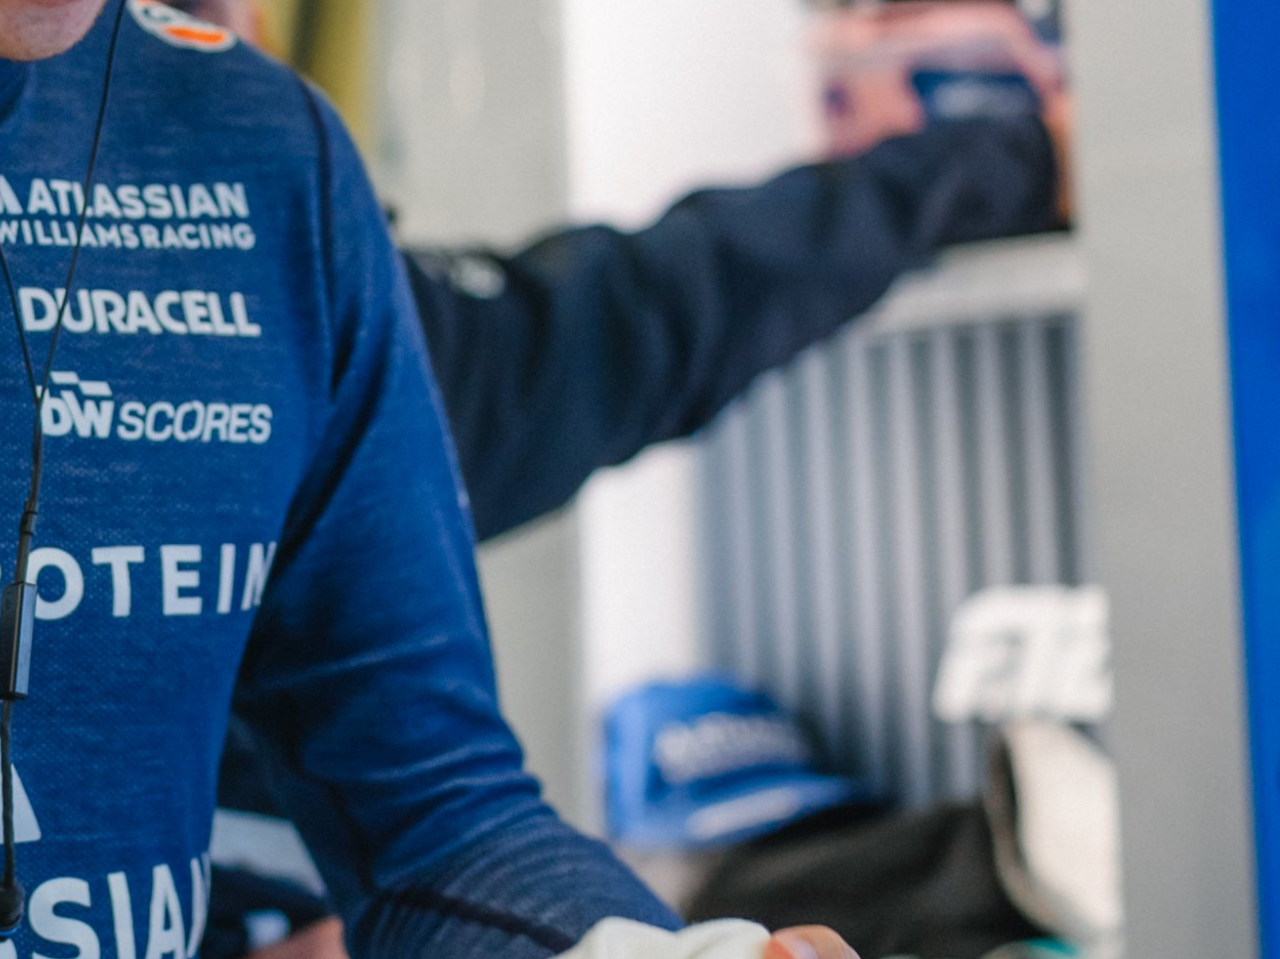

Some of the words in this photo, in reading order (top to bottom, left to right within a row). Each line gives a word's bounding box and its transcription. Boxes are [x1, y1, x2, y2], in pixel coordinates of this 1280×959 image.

[27, 178, 250, 219] ATLASSIAN
[139, 222, 256, 250] RACING
[18, 287, 261, 338] DURACELL
[116, 400, 274, 445] SCORES
